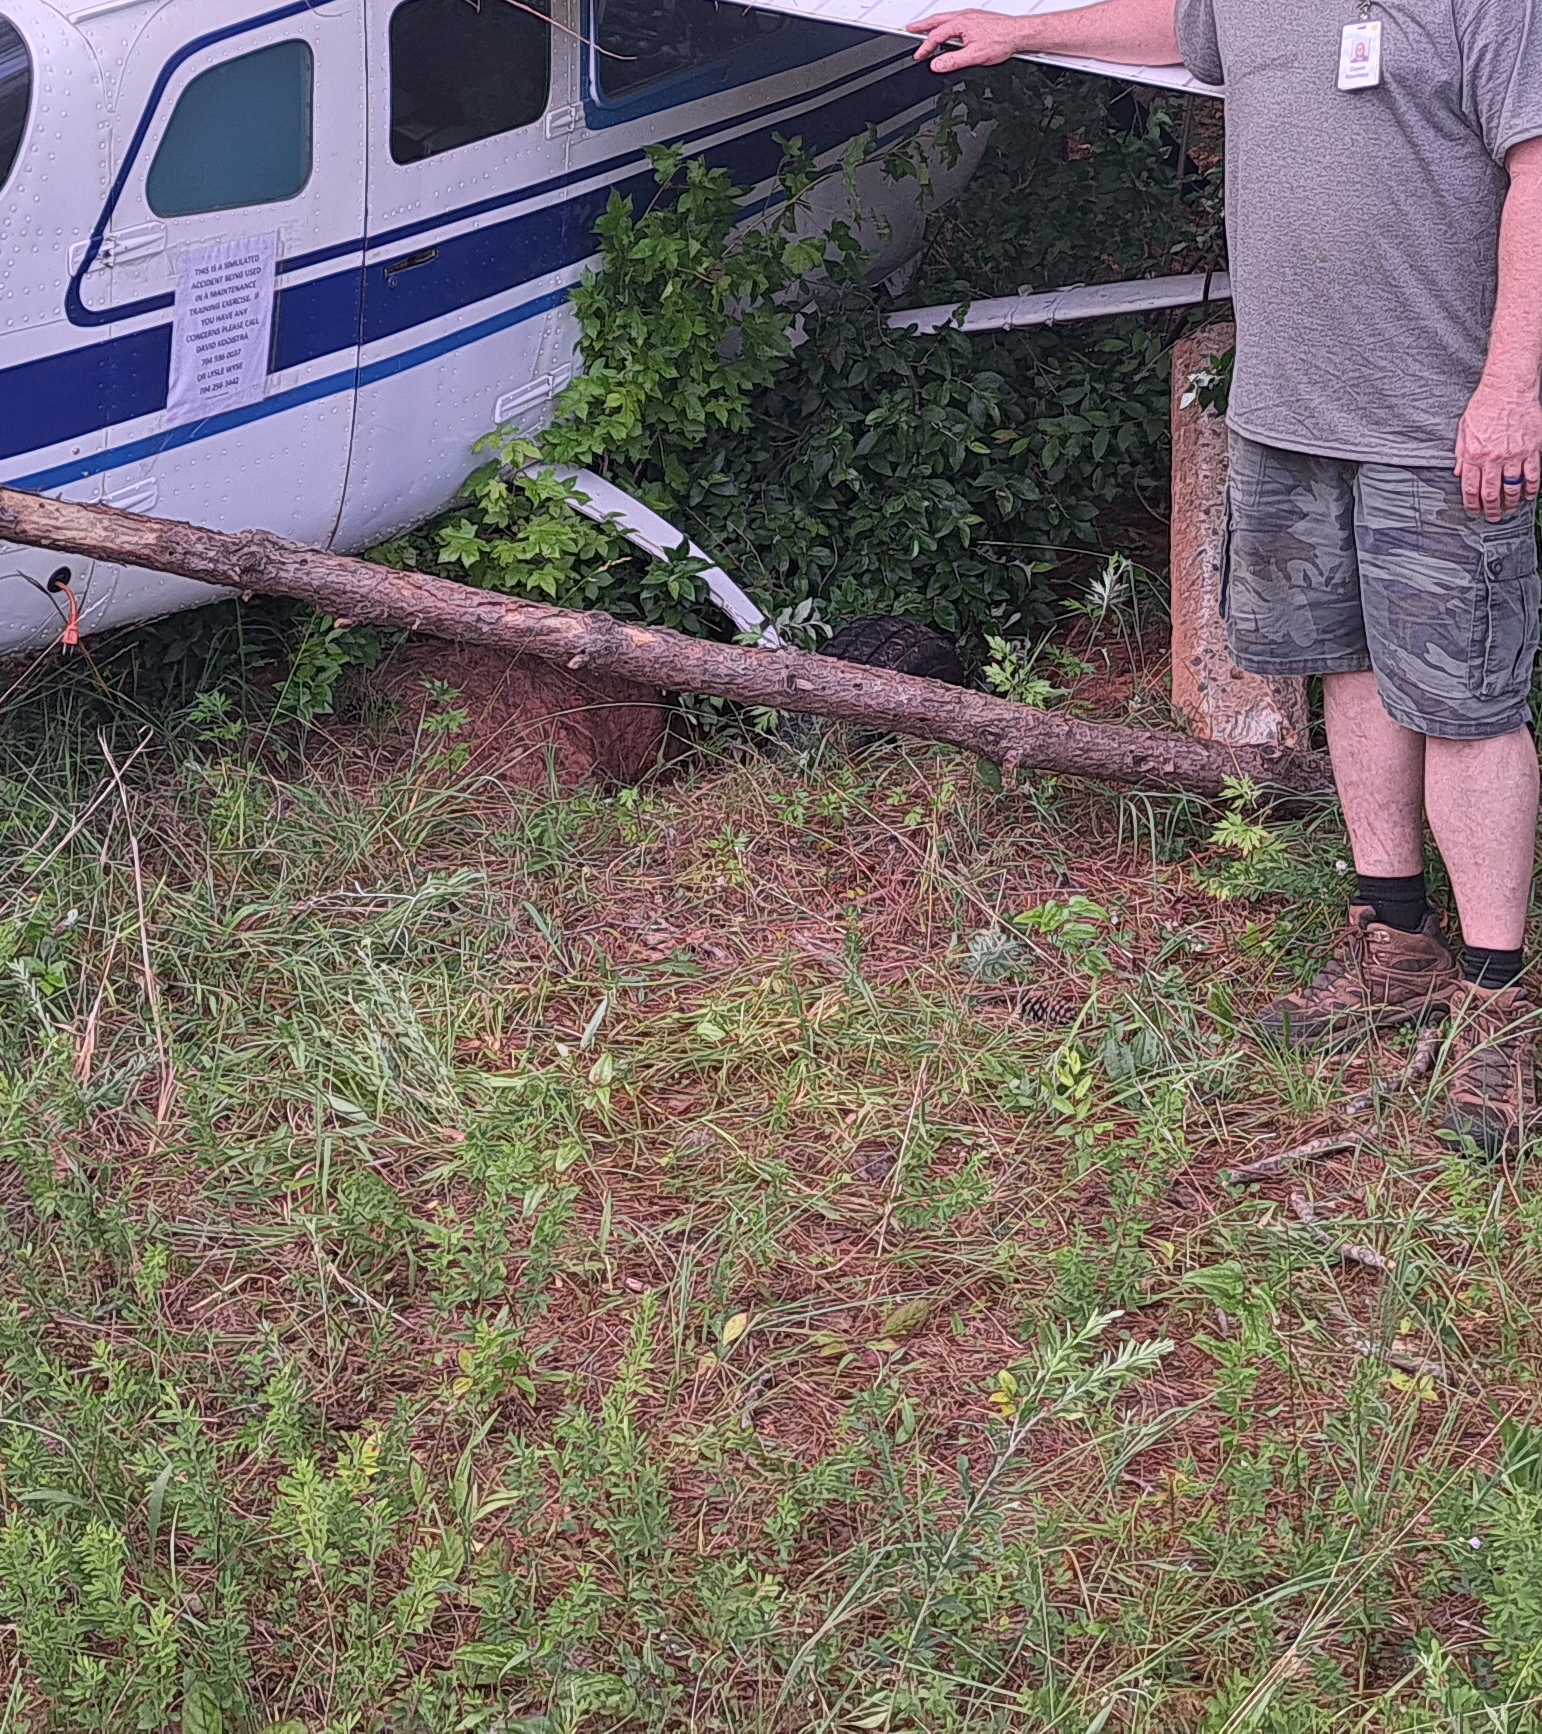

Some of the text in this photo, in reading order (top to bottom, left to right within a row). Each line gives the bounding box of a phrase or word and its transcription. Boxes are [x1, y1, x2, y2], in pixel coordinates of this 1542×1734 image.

[195, 255, 259, 276] THIS IS A SIMULATED
[191, 267, 261, 290] ACCIDENT BEING USED
[195, 280, 257, 302] IN A MAINTENANCE
[189, 302, 221, 316] TRAINING
[201, 308, 248, 327] YOU HAVE ANY
[186, 317, 259, 343] CONCERNS PLEASE CALL
[196, 342, 216, 354] DAVID
[196, 372, 207, 382] OR
